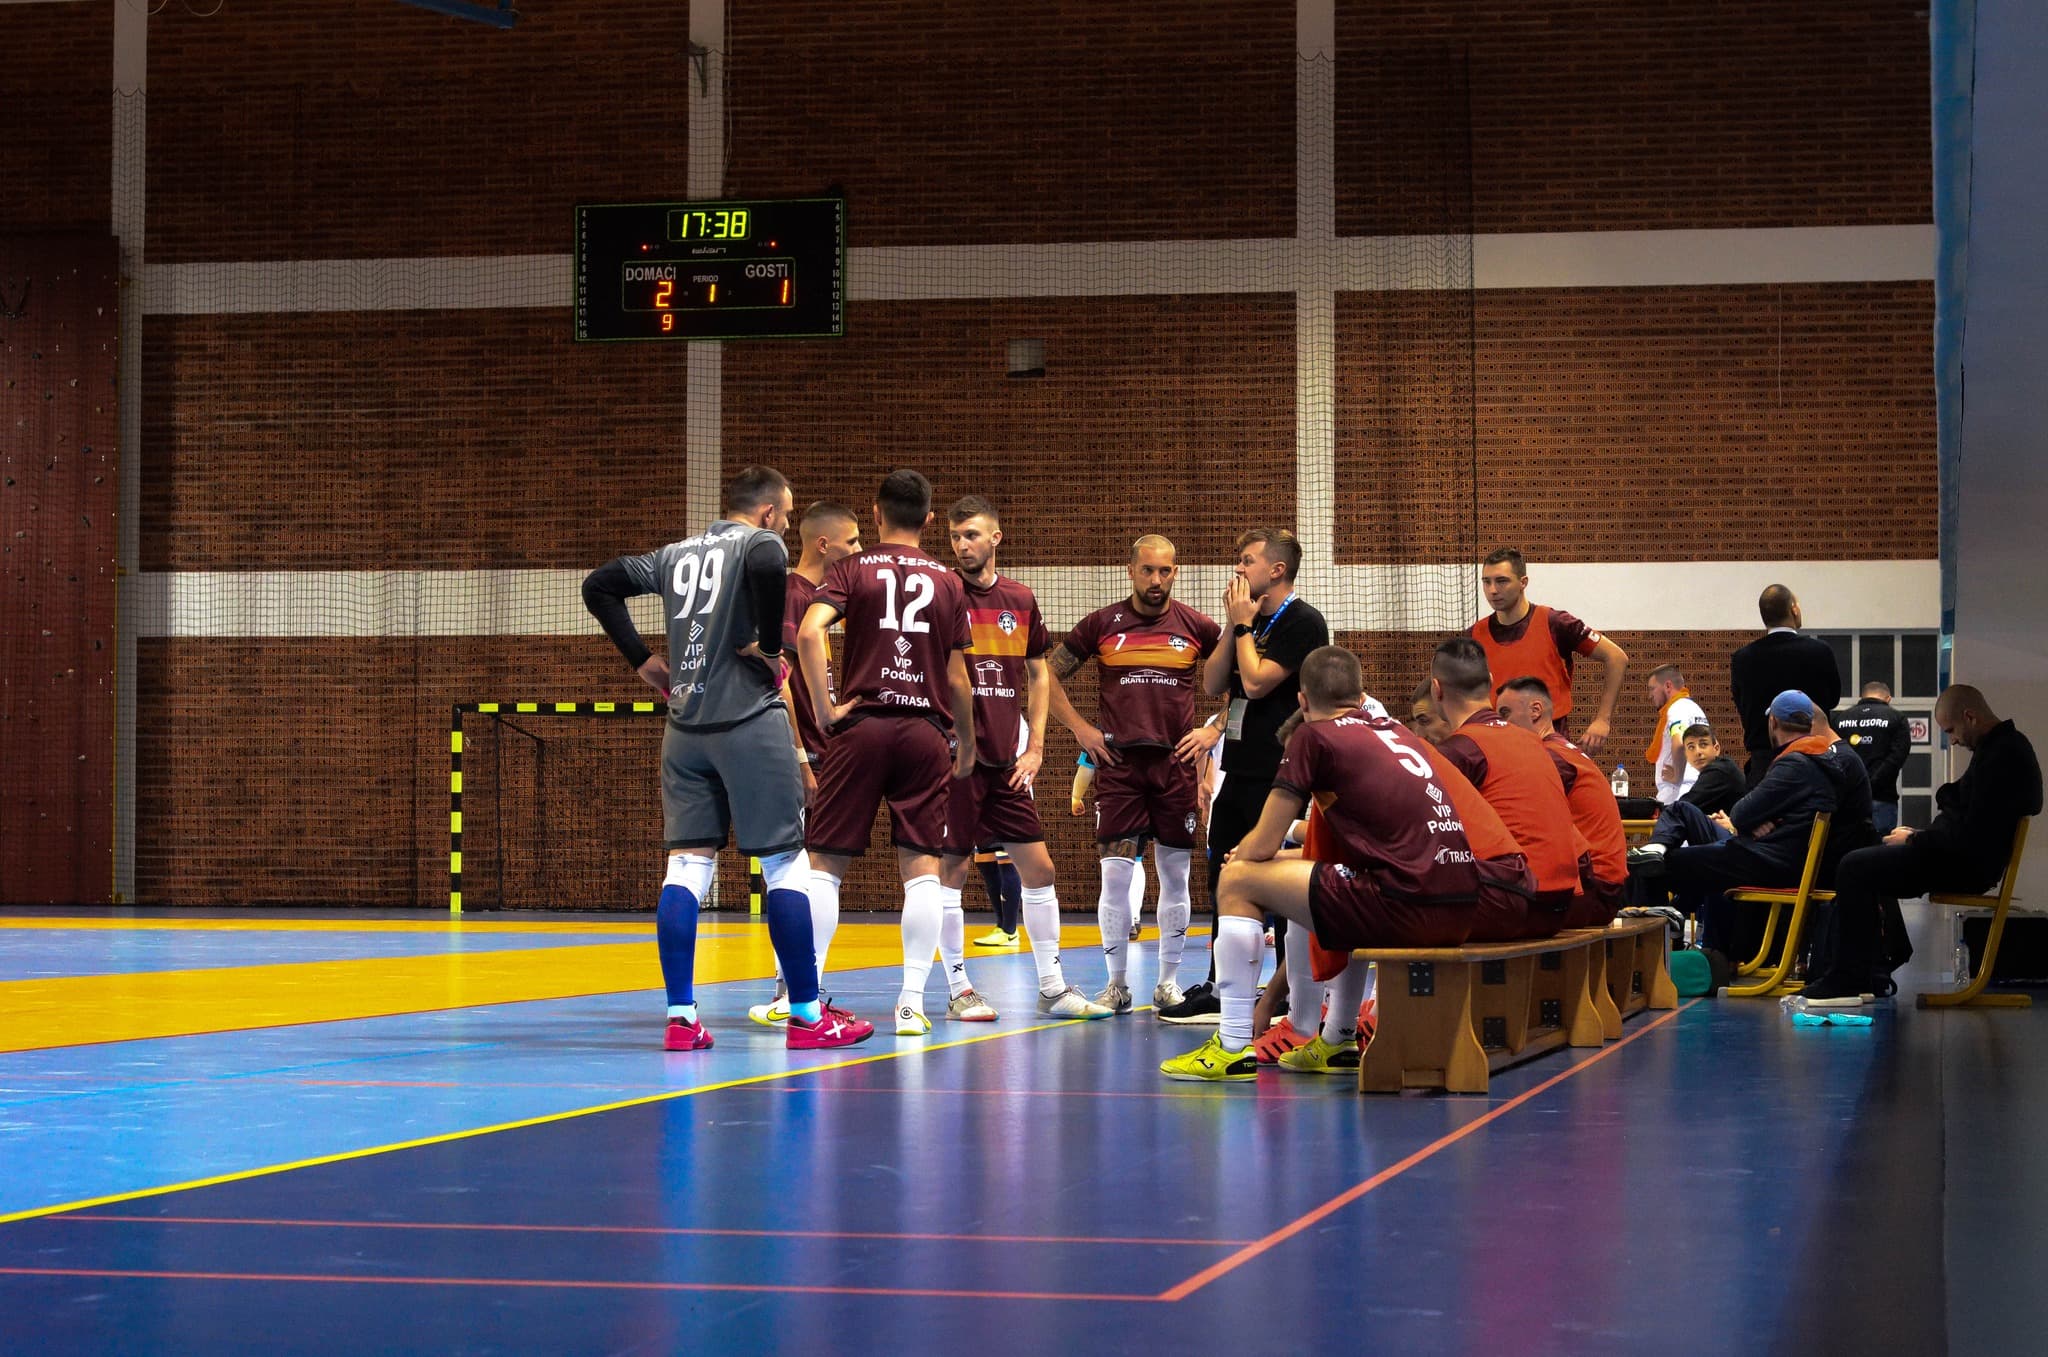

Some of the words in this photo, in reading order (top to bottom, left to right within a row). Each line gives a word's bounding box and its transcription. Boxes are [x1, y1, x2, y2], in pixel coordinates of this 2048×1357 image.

[682, 210, 748, 238] 17:38
[692, 274, 719, 283] PERIOD
[745, 263, 788, 279] GOSTI
[655, 281, 672, 307] 2
[709, 284, 716, 303] 1
[783, 279, 788, 303] 1
[662, 314, 673, 331] 9
[860, 554, 895, 565] MNK
[673, 547, 725, 620] 99
[877, 568, 935, 634] 12
[1114, 633, 1126, 650] 7
[893, 655, 913, 670] VIP
[880, 667, 924, 684] Podovi
[894, 694, 931, 708] TRASA
[1859, 718, 1889, 728] USORA
[1372, 729, 1433, 779] 5
[1432, 804, 1452, 818] VIP
[1448, 850, 1476, 864] TRASA
